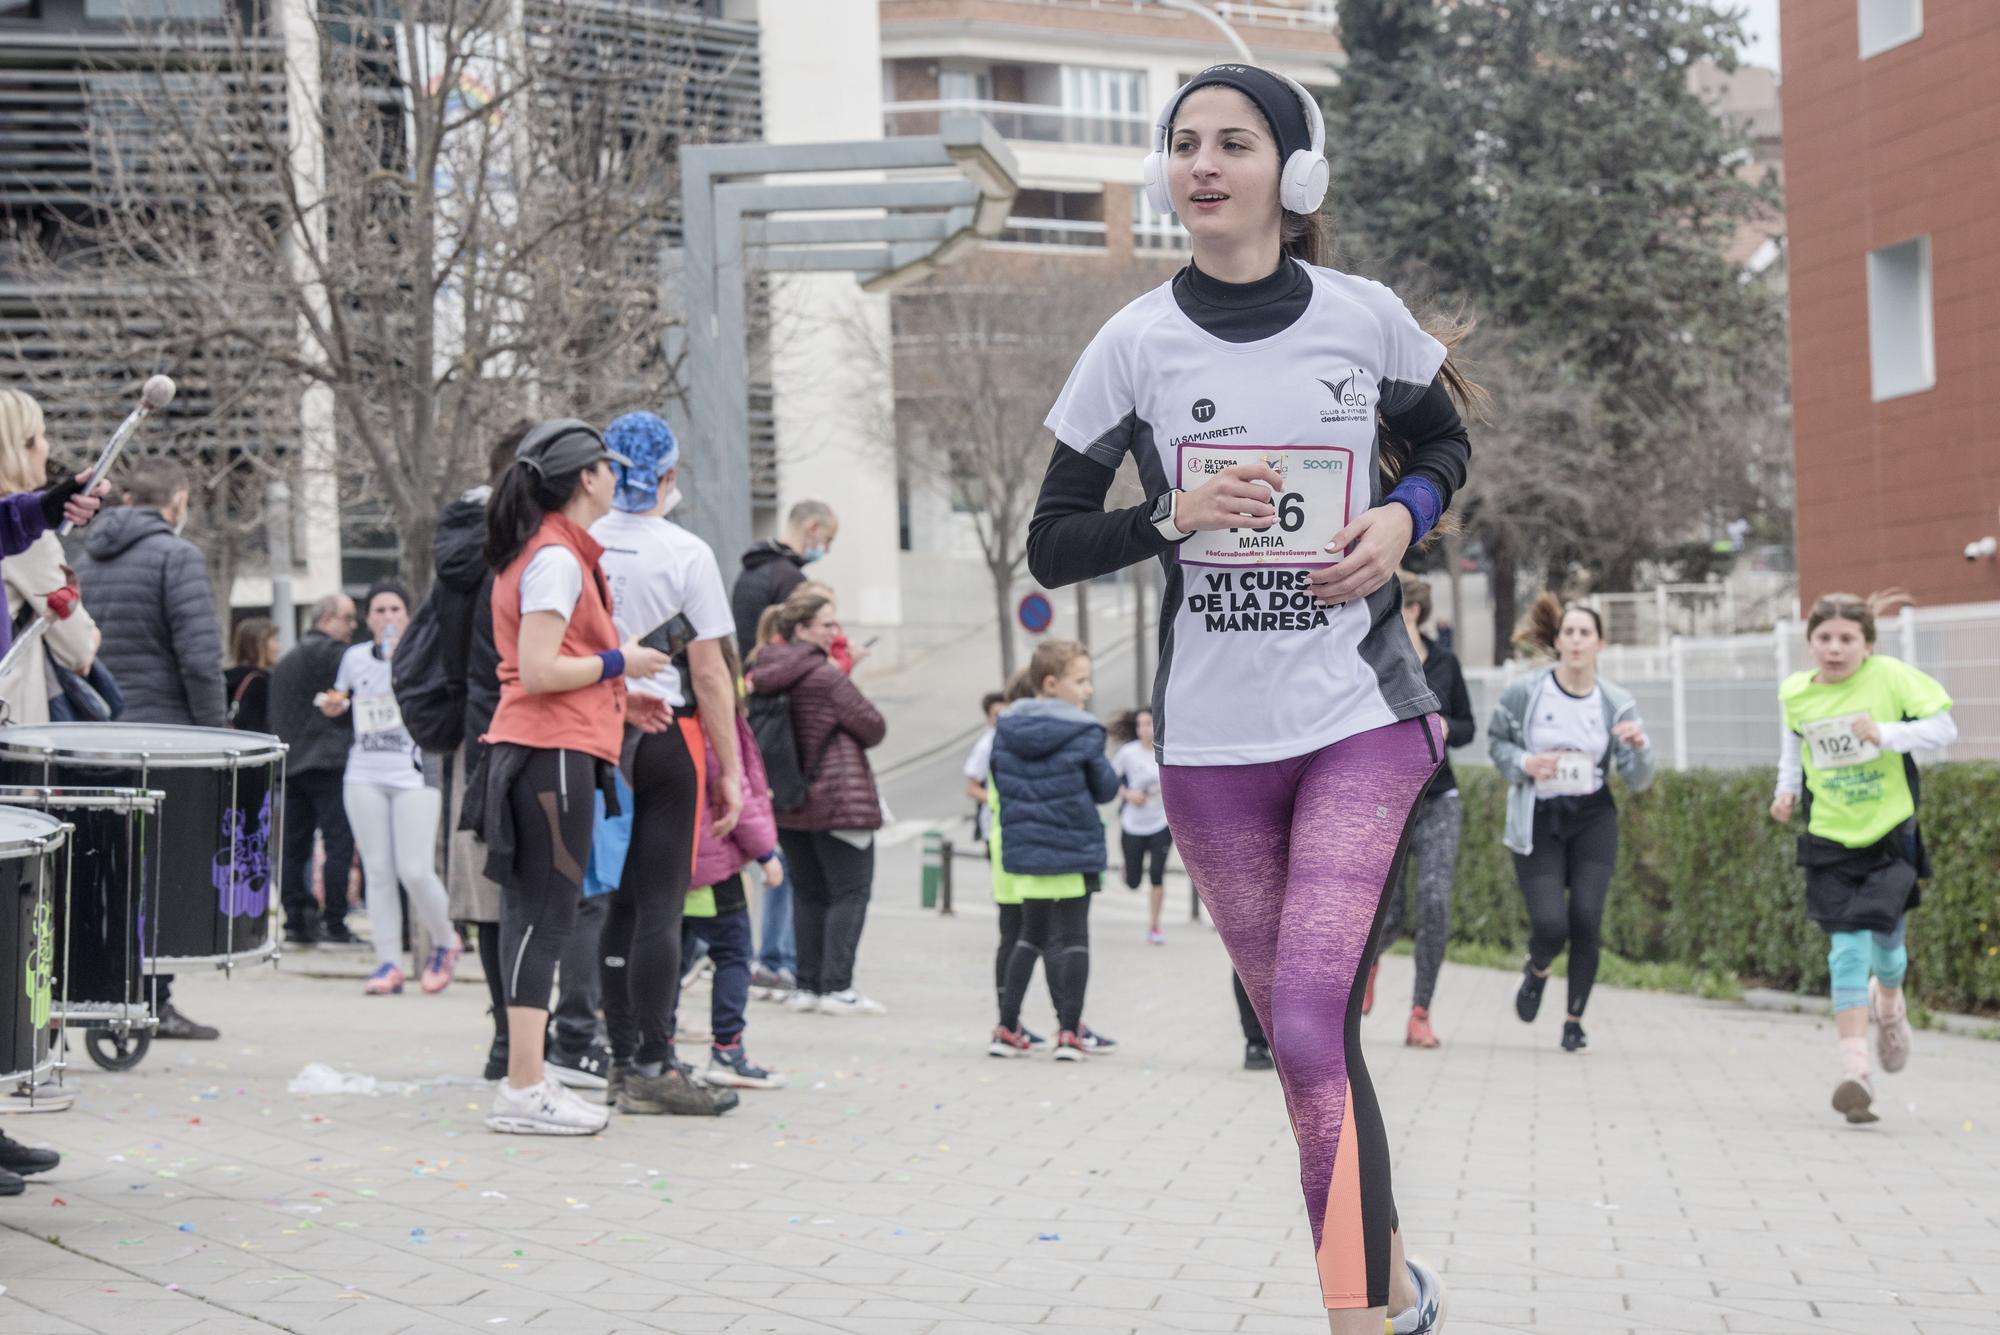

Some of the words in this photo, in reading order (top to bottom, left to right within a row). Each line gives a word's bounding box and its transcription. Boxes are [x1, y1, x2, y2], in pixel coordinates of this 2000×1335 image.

[1181, 425, 1248, 444] SAMARRETTA
[1239, 536, 1285, 549] MARIA
[1205, 573, 1232, 592] VI
[1240, 571, 1318, 591] CURS
[1188, 594, 1223, 613] DE
[1230, 593, 1261, 612] LA
[1205, 610, 1330, 633] MANRESA
